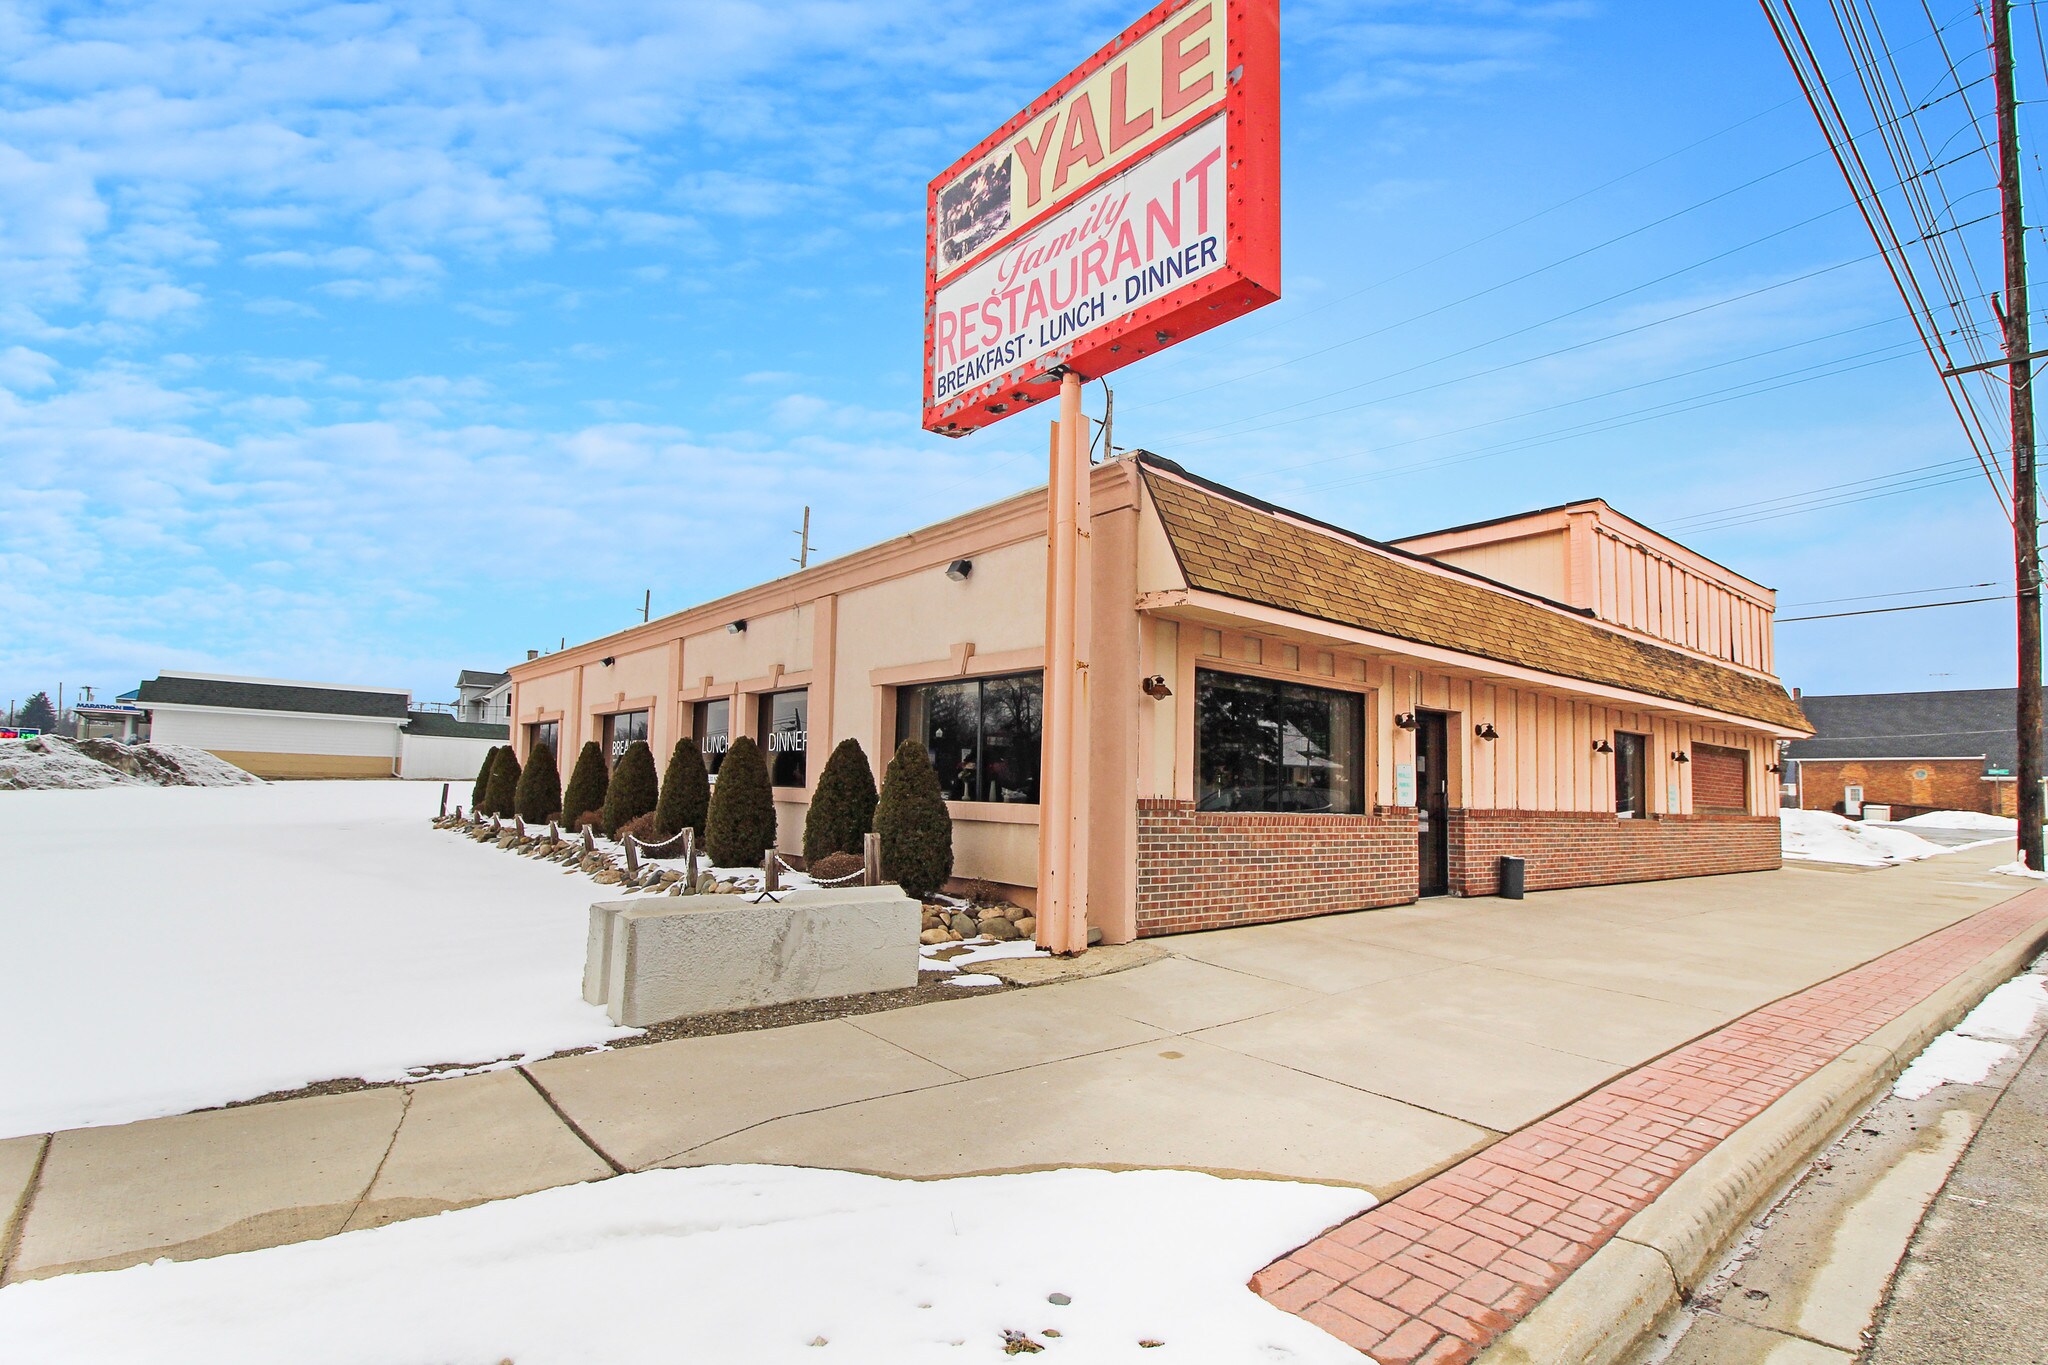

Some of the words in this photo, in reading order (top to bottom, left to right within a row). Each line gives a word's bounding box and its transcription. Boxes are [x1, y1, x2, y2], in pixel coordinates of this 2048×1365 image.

[1014, 5, 1213, 209] YALE
[937, 333, 1025, 399] BREAKFAST
[1040, 291, 1105, 348] LUNCH
[1125, 236, 1218, 304] DINNER
[938, 145, 1221, 374] RESTAURANT
[991, 191, 1131, 295] Family
